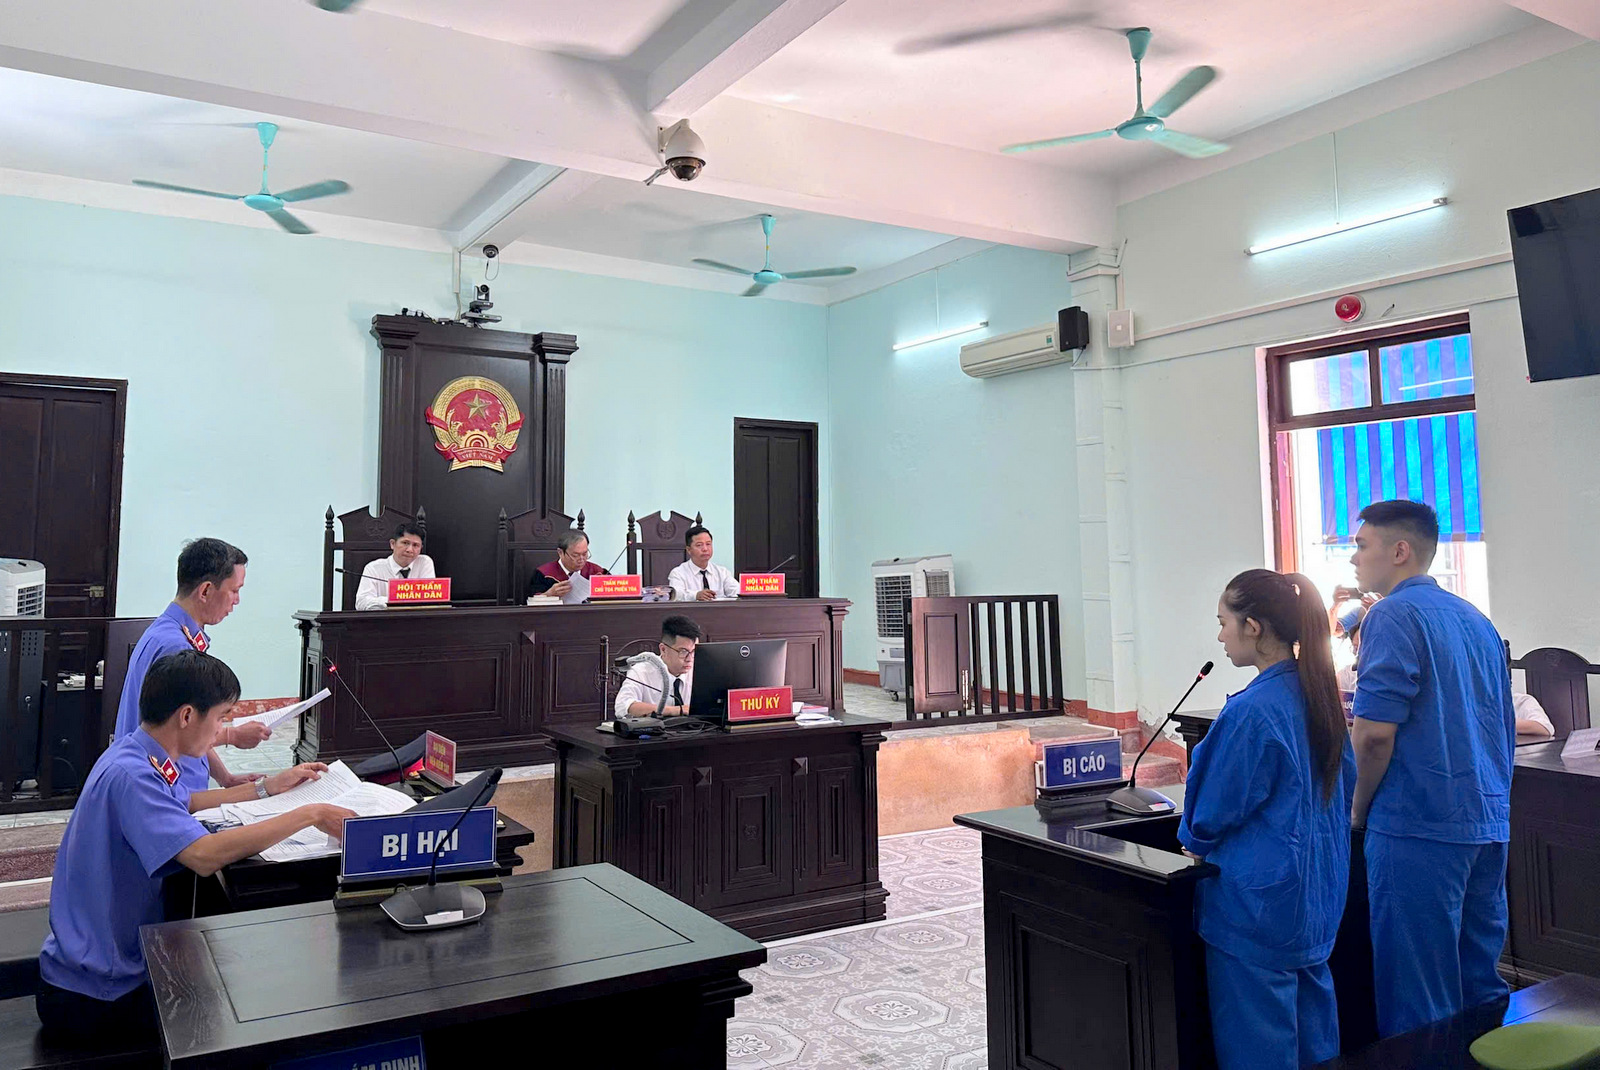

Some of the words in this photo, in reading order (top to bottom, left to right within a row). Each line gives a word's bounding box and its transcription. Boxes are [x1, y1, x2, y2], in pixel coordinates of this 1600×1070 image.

[397, 582, 414, 592] HỘI
[415, 580, 442, 591] THẨM
[746, 577, 758, 585] HỘI
[760, 576, 779, 584] THẨM
[745, 584, 764, 592] NHÂN
[396, 590, 422, 600] NHÂN
[423, 590, 443, 599] DÂN
[740, 695, 764, 711] THƯ
[765, 693, 780, 709] KÝ
[1063, 757, 1077, 778] BỊ
[1080, 751, 1106, 773] CÁO
[382, 833, 408, 861] BỊ
[417, 828, 459, 858] HẠI
